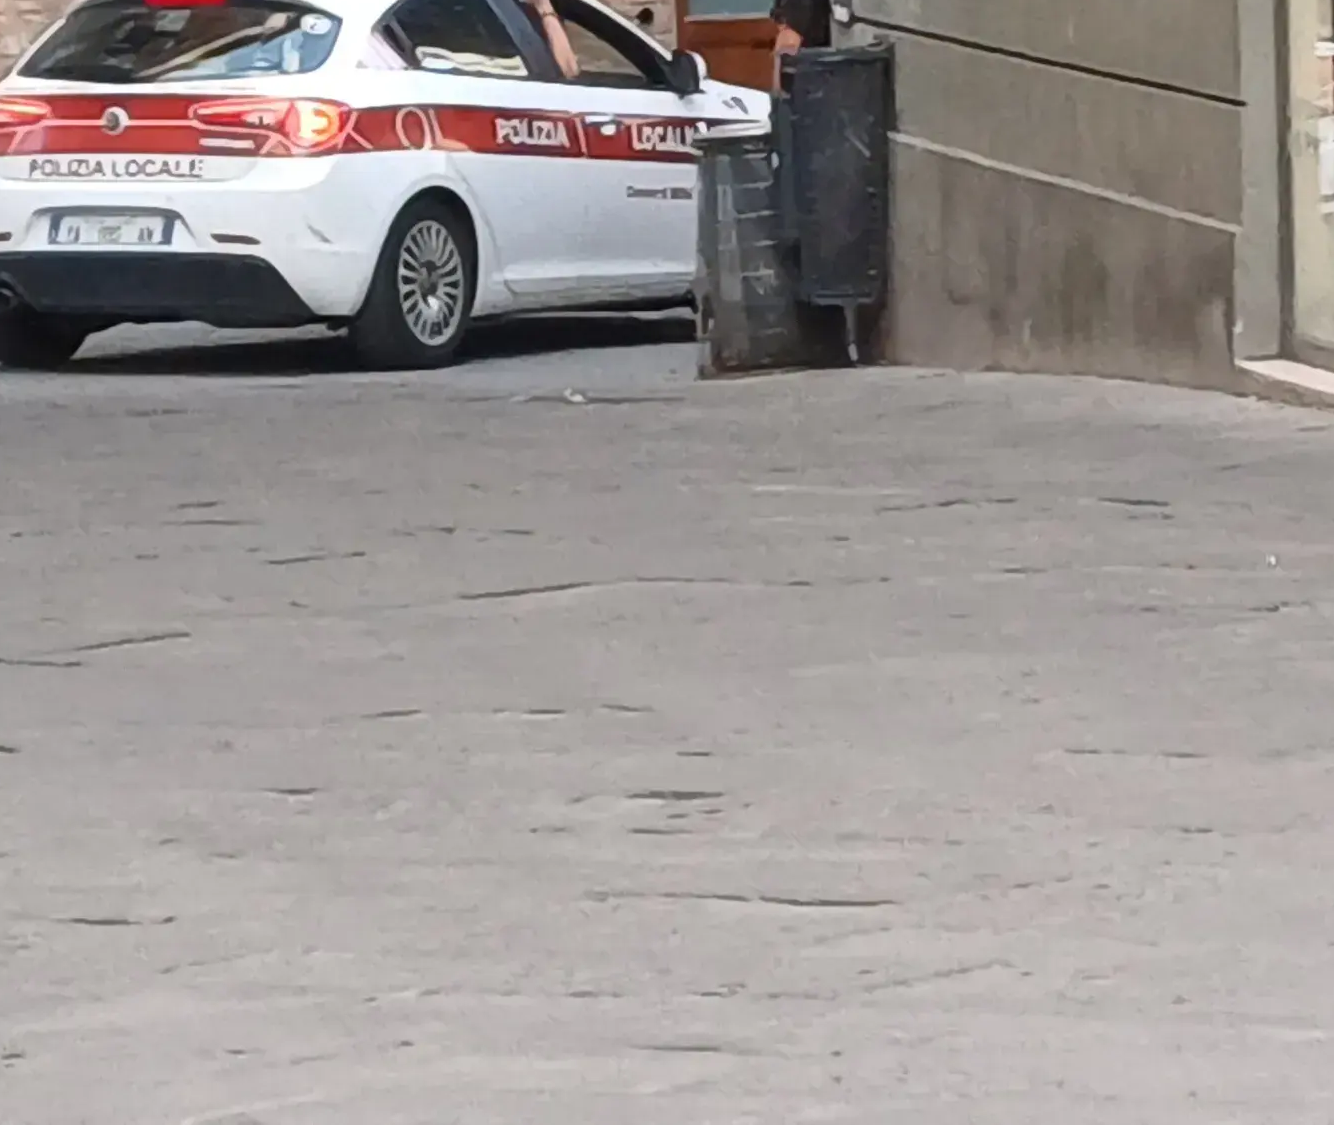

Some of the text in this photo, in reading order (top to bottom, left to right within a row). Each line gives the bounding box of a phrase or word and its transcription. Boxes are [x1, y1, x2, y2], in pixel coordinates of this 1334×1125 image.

[496, 118, 571, 149] POLIZIA
[29, 159, 204, 178] POLIZIA LOCALE
